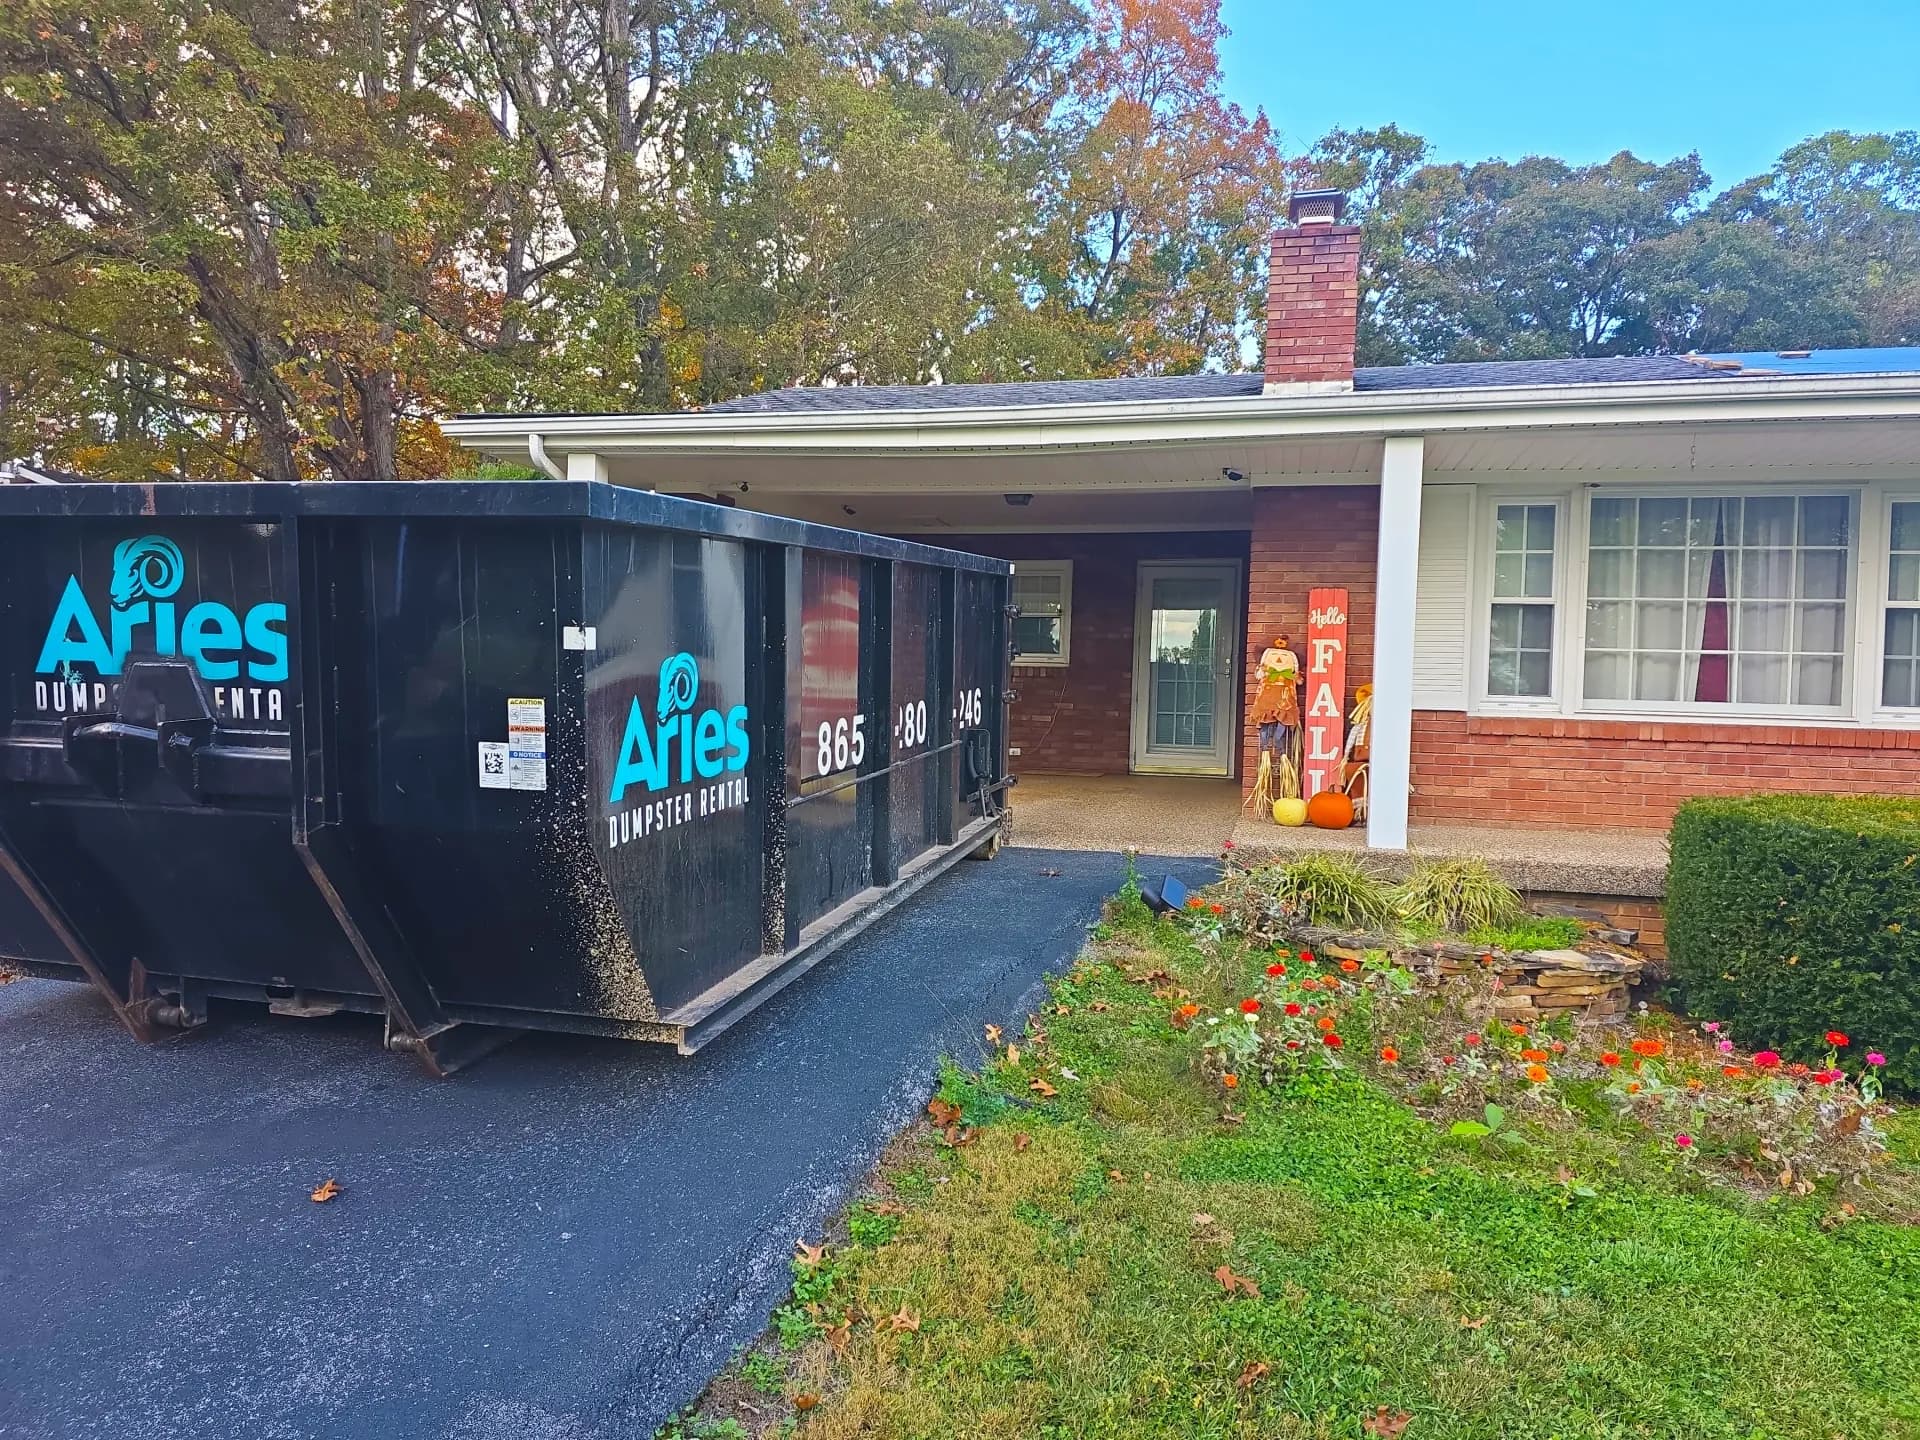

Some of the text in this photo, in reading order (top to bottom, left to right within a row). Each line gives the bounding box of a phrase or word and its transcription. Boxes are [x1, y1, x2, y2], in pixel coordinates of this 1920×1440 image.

[35, 574, 288, 682] Aries
[1309, 607, 1347, 629] Hello
[609, 694, 750, 803] Aries
[817, 714, 865, 776] 865
[609, 777, 750, 849] DUMPSTER RENTAL
